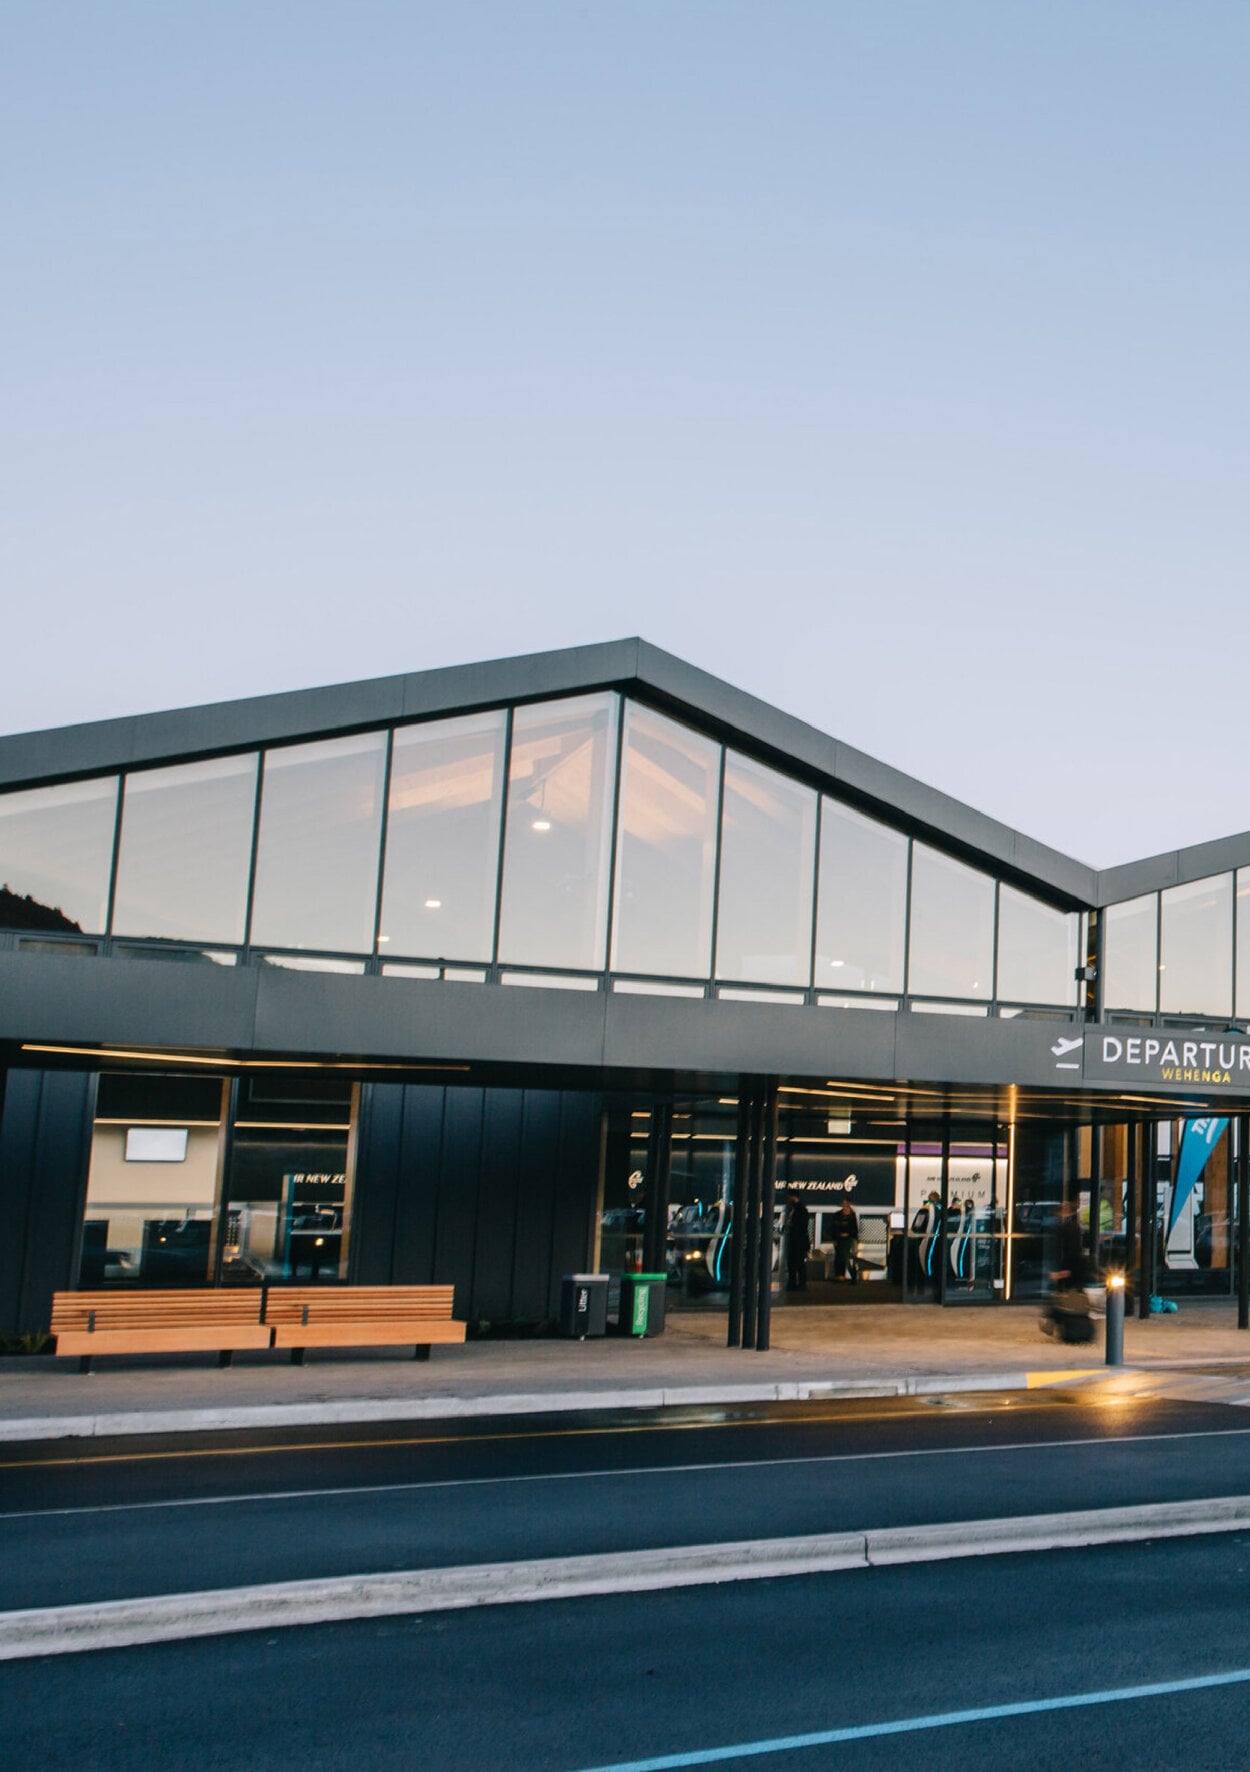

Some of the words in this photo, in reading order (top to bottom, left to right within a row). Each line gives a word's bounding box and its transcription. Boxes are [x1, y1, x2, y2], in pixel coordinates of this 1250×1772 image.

[1161, 1068, 1231, 1083] WEHENGA
[294, 1173, 305, 1184] IR
[305, 1173, 331, 1184] NEW
[331, 1173, 346, 1184] ZE
[787, 1180, 807, 1190] NEW
[806, 1181, 843, 1190] ZEALAND
[920, 1189, 986, 1198] PMIUM
[578, 1288, 588, 1312] Litter
